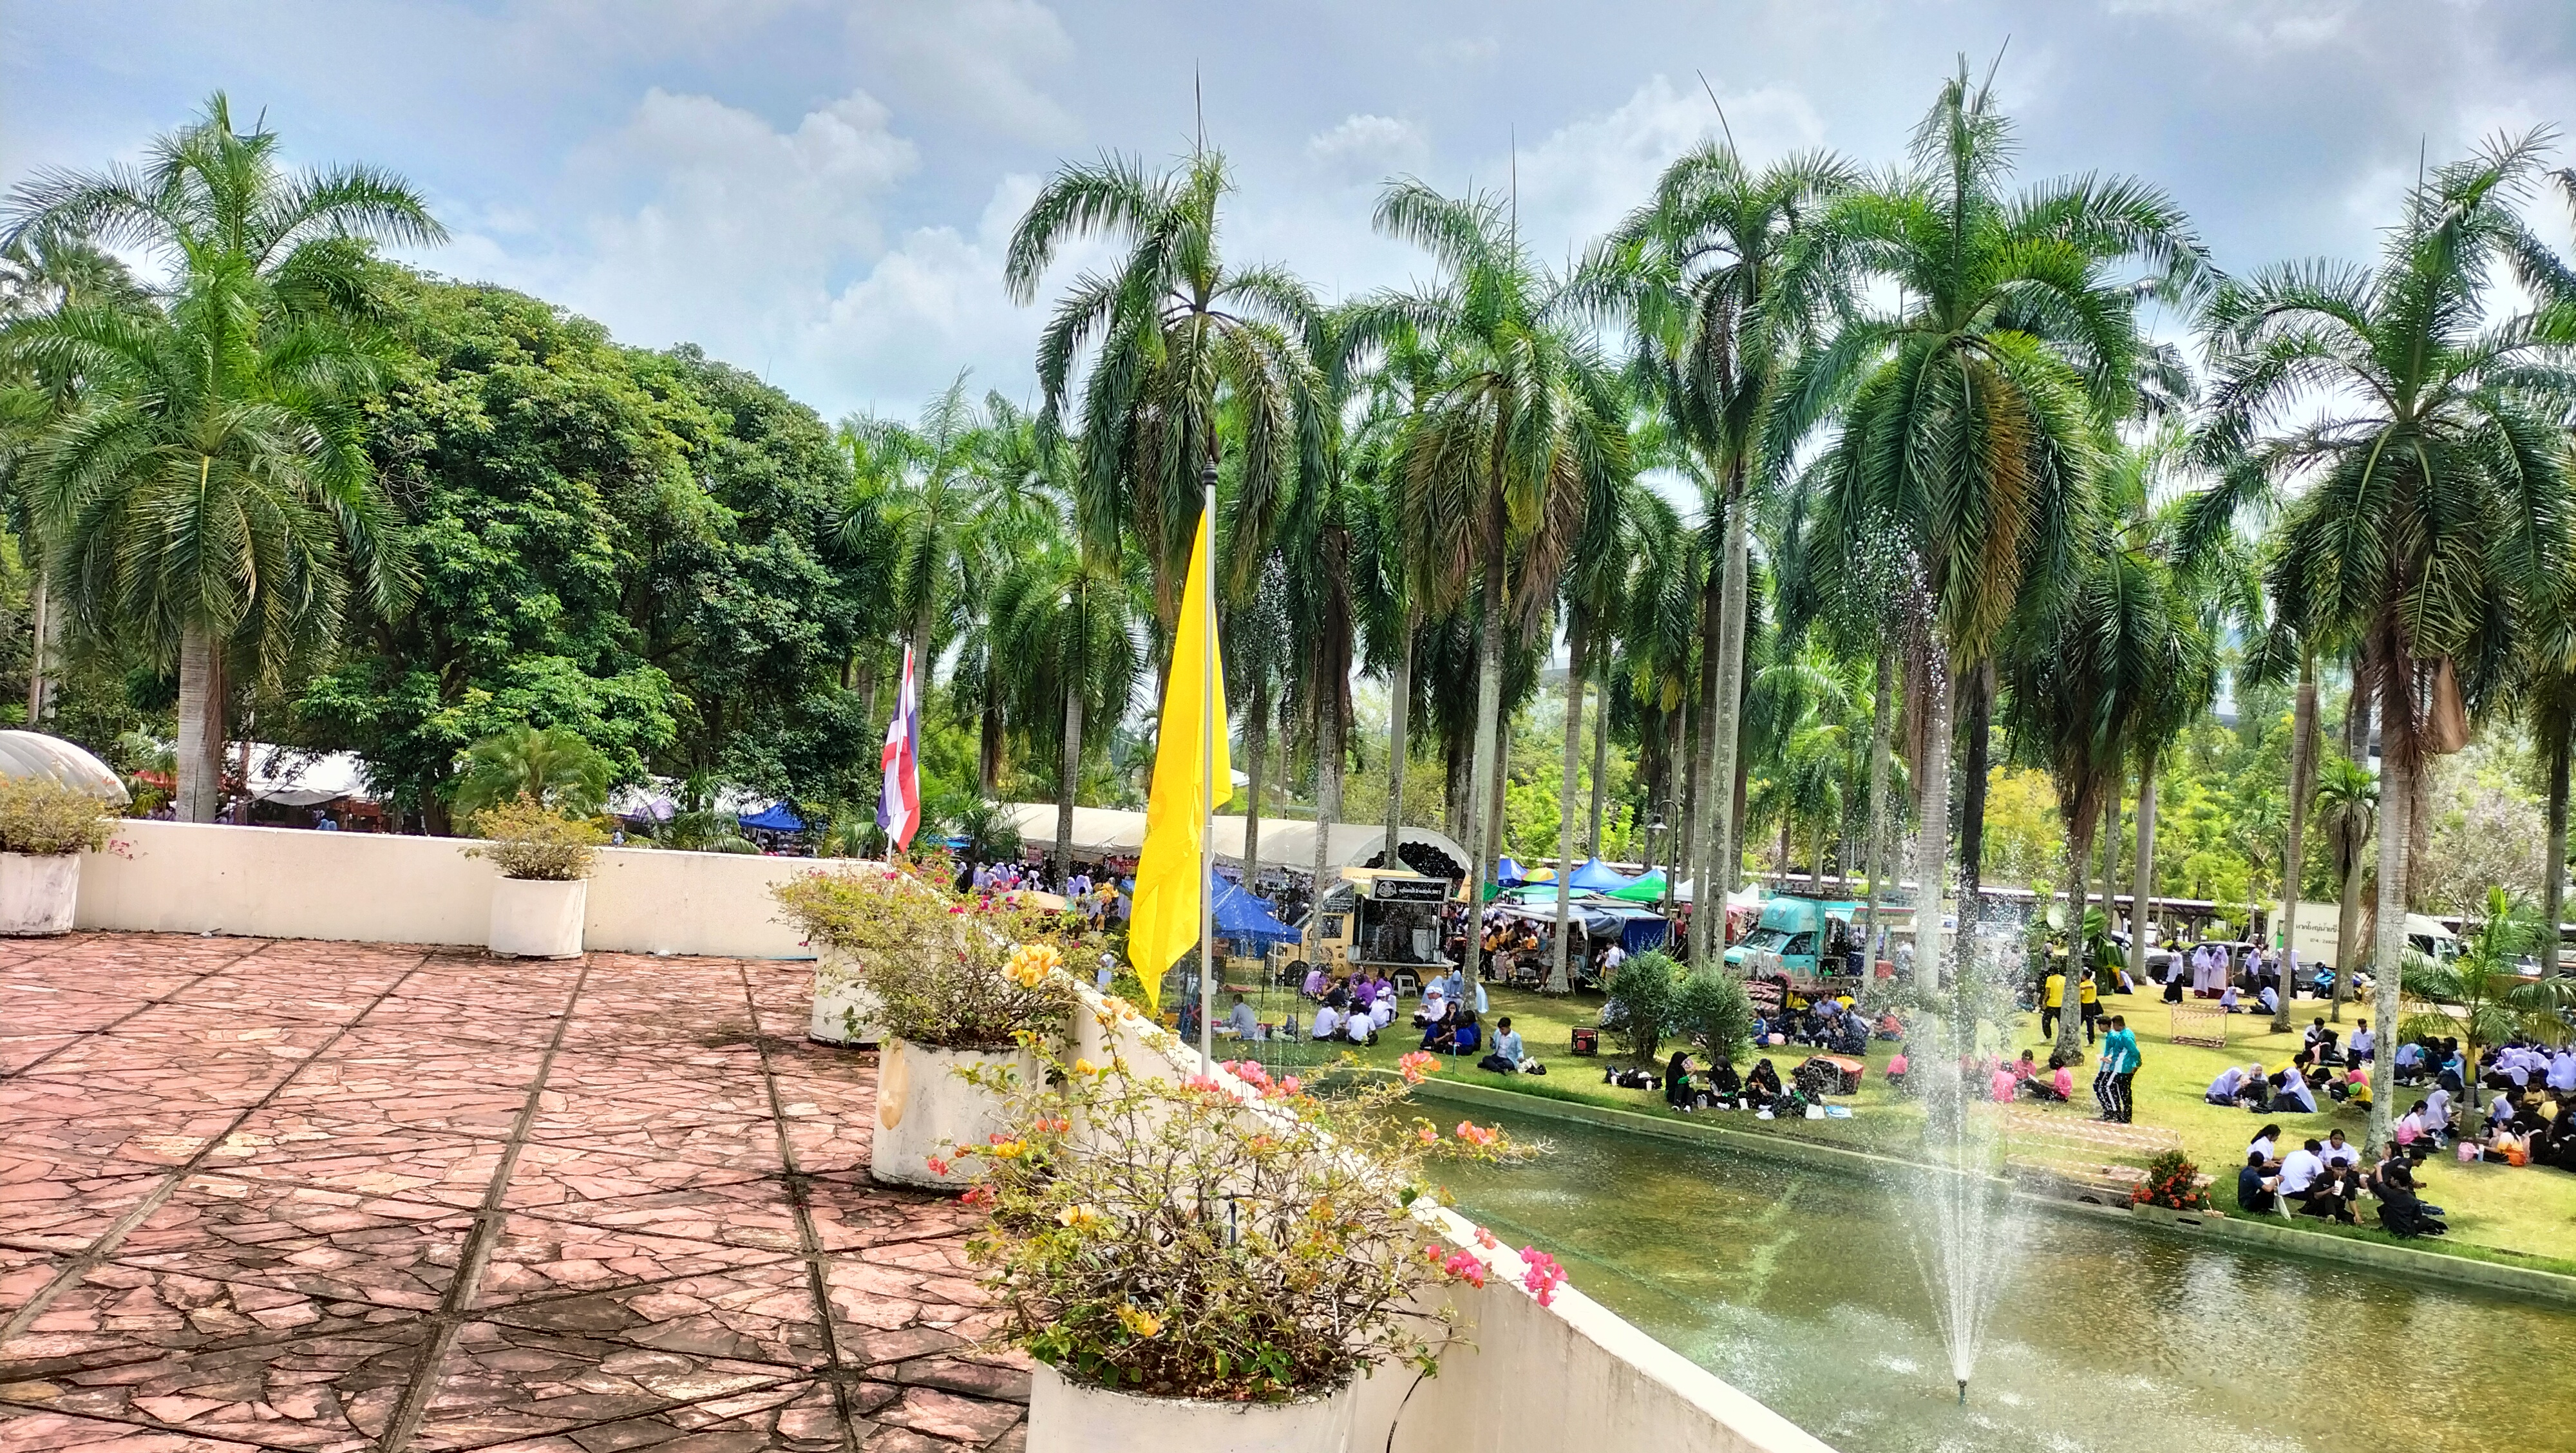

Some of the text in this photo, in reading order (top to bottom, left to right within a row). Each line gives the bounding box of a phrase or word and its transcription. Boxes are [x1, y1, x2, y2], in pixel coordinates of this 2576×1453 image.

[2296, 921, 2339, 933] หาดใหญ่น้ำแข็
